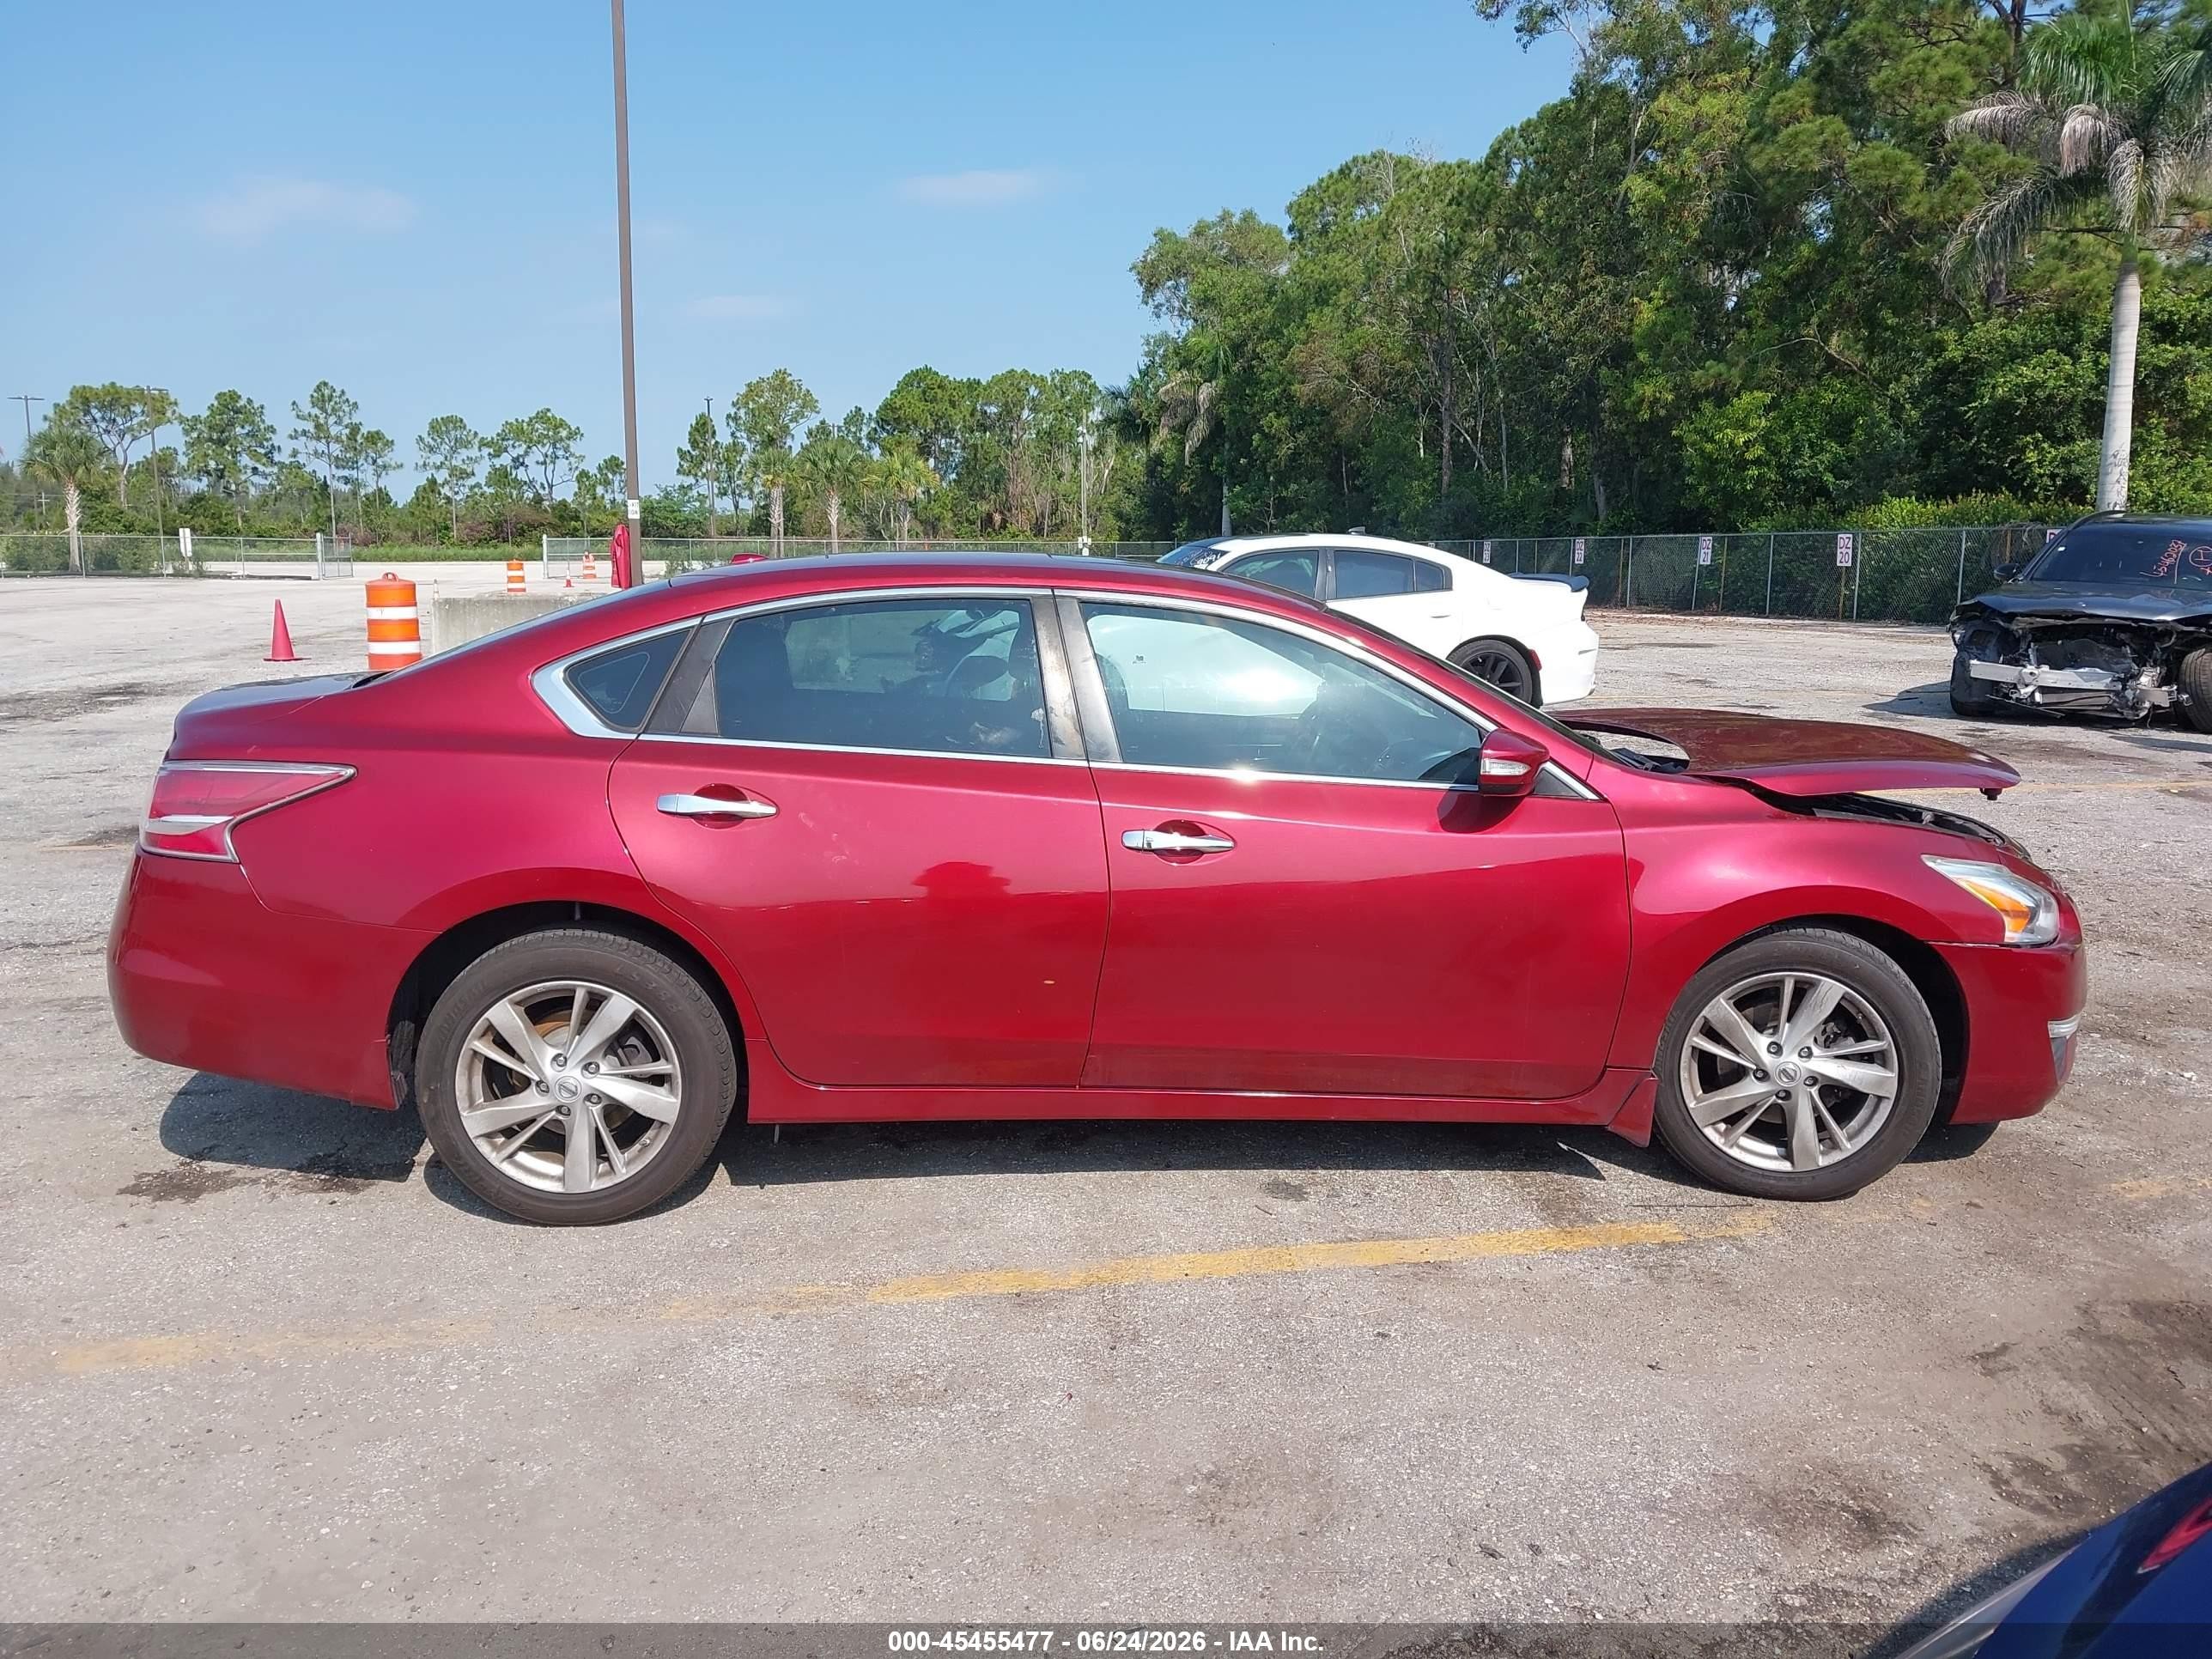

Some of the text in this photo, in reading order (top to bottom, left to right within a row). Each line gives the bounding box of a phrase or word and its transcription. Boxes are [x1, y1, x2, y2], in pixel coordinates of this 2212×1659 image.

[1576, 541, 1583, 550] DZ
[1702, 538, 1711, 550] DZ
[1838, 536, 1851, 550] DZ
[1576, 551, 1583, 562] 22
[1702, 551, 1710, 563] 21
[1838, 551, 1850, 564] 20
